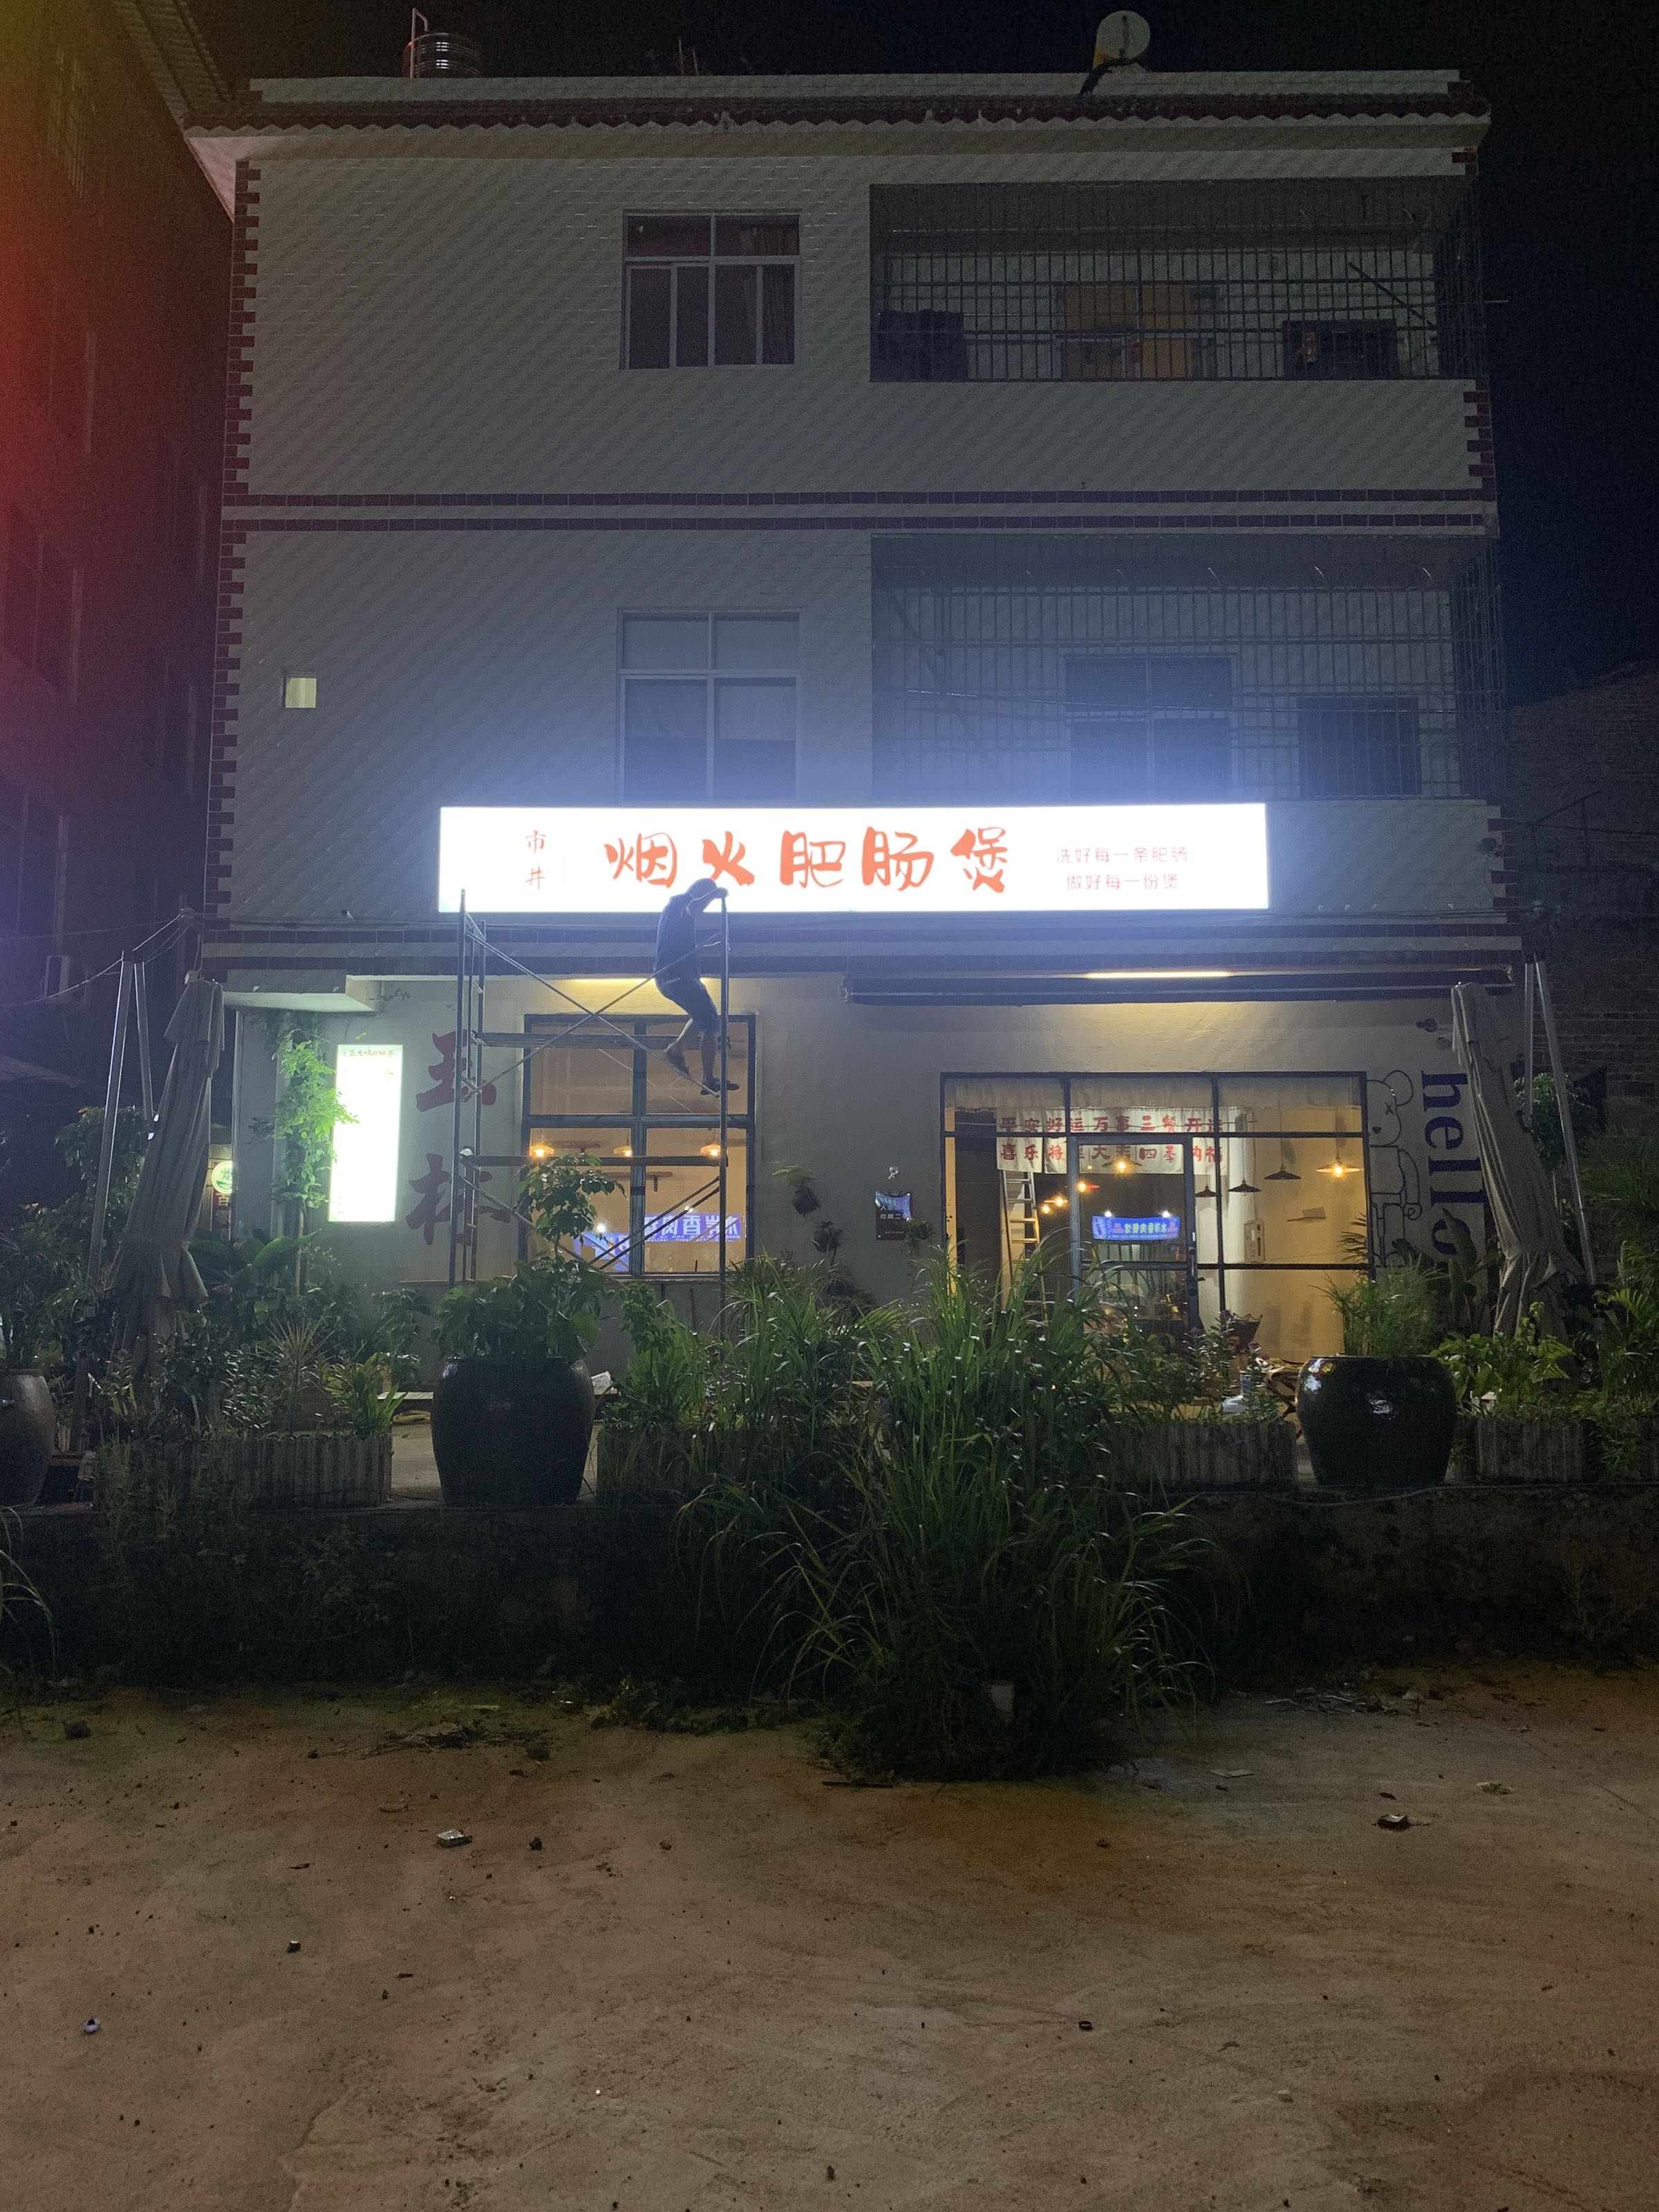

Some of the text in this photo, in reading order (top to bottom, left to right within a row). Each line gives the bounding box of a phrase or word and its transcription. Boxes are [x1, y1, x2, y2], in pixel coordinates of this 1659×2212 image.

[526, 830, 547, 891] 市井
[603, 825, 1008, 894] 烟火肥肠煲
[1056, 846, 1188, 863] 洗好每一条肥肠
[1065, 872, 1179, 890] 做好每一份煲
